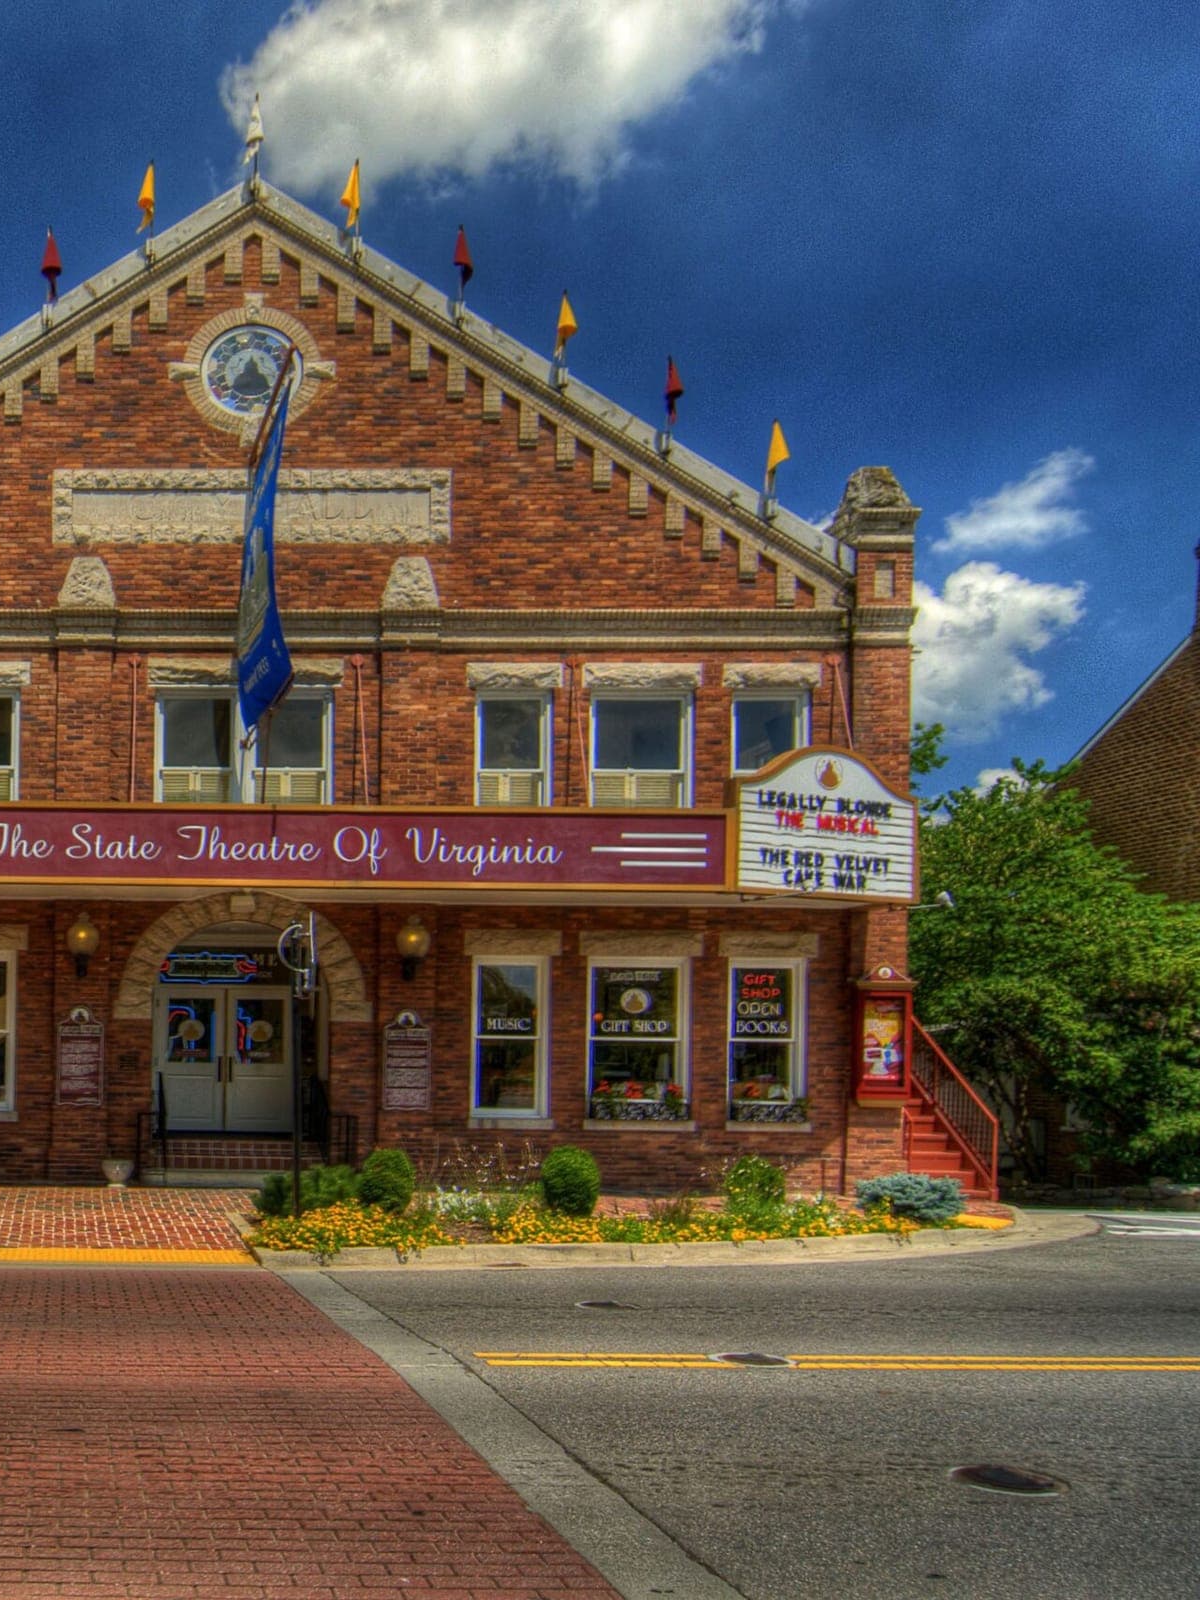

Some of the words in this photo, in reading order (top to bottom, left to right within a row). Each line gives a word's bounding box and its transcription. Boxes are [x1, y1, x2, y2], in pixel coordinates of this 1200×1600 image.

[758, 790, 826, 810] LEGALLY
[837, 798, 892, 818] BLONDE
[775, 810, 804, 829] THE
[816, 814, 880, 835] MUSICAL
[65, 823, 161, 860] State
[177, 825, 321, 861] Theatre
[333, 826, 387, 875] Of
[405, 827, 563, 876] Virginia
[760, 848, 789, 865] THE
[794, 850, 824, 867] RED
[835, 854, 890, 874] VELVET
[833, 871, 866, 890] WAR
[743, 973, 776, 985] GIFT
[741, 987, 781, 999] SHOP
[737, 1001, 781, 1016] OPEN
[486, 1017, 531, 1031] MUSIC
[601, 1020, 629, 1032] GIFT
[632, 1020, 668, 1032] SHOP
[736, 1020, 788, 1034] BOOKS
